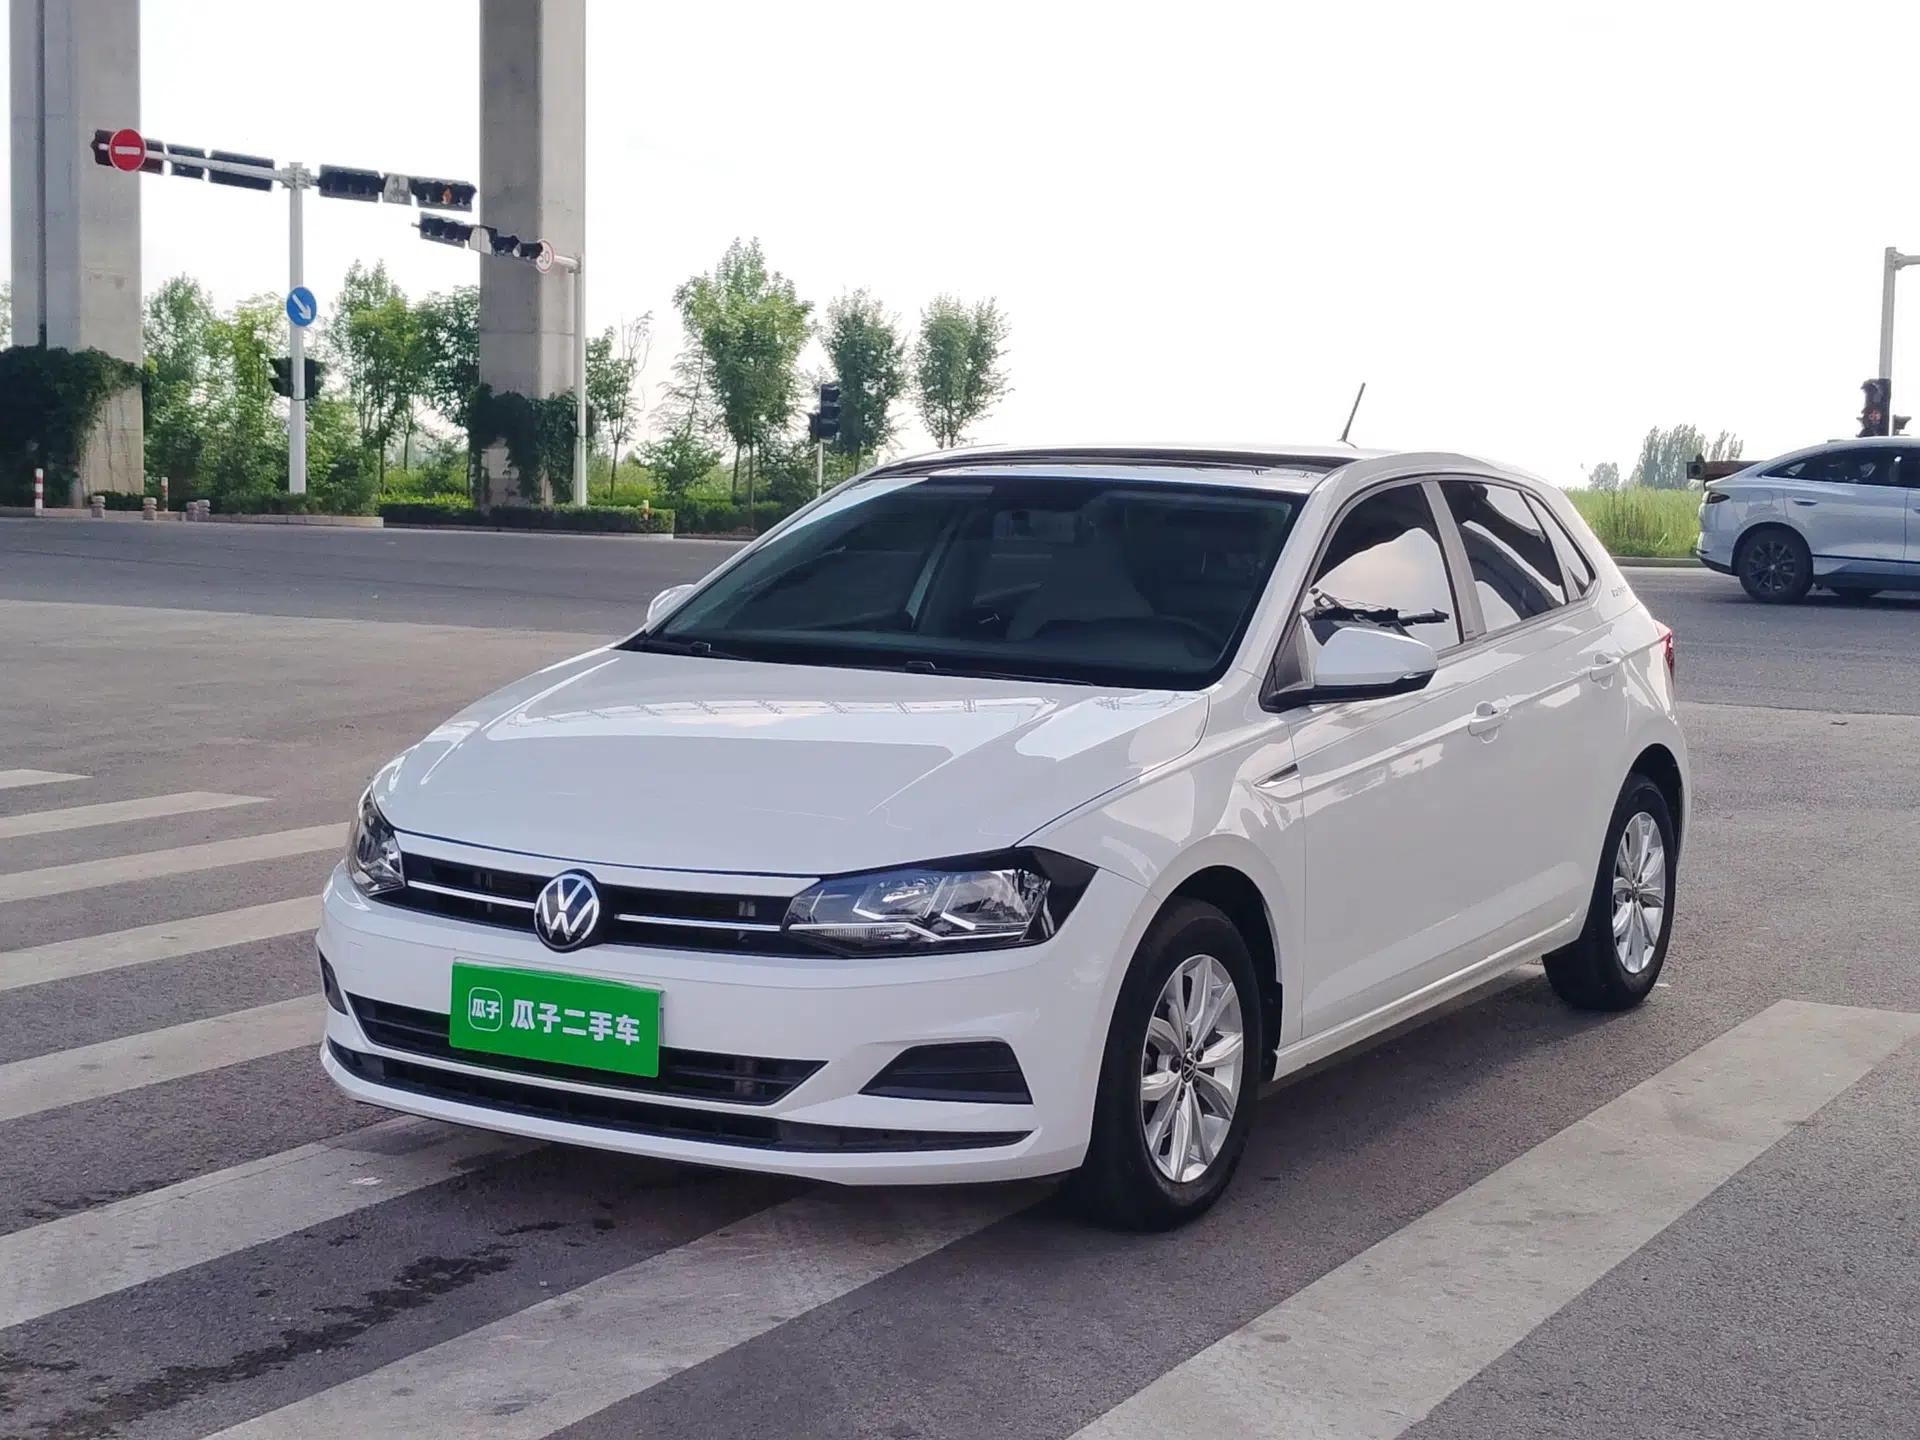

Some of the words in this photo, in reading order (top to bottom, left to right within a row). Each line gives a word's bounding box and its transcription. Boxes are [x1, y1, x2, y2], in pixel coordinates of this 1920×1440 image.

[537, 873, 599, 946] VW
[471, 998, 500, 1020] 瓜子
[510, 999, 640, 1046] 瓜子二手车
